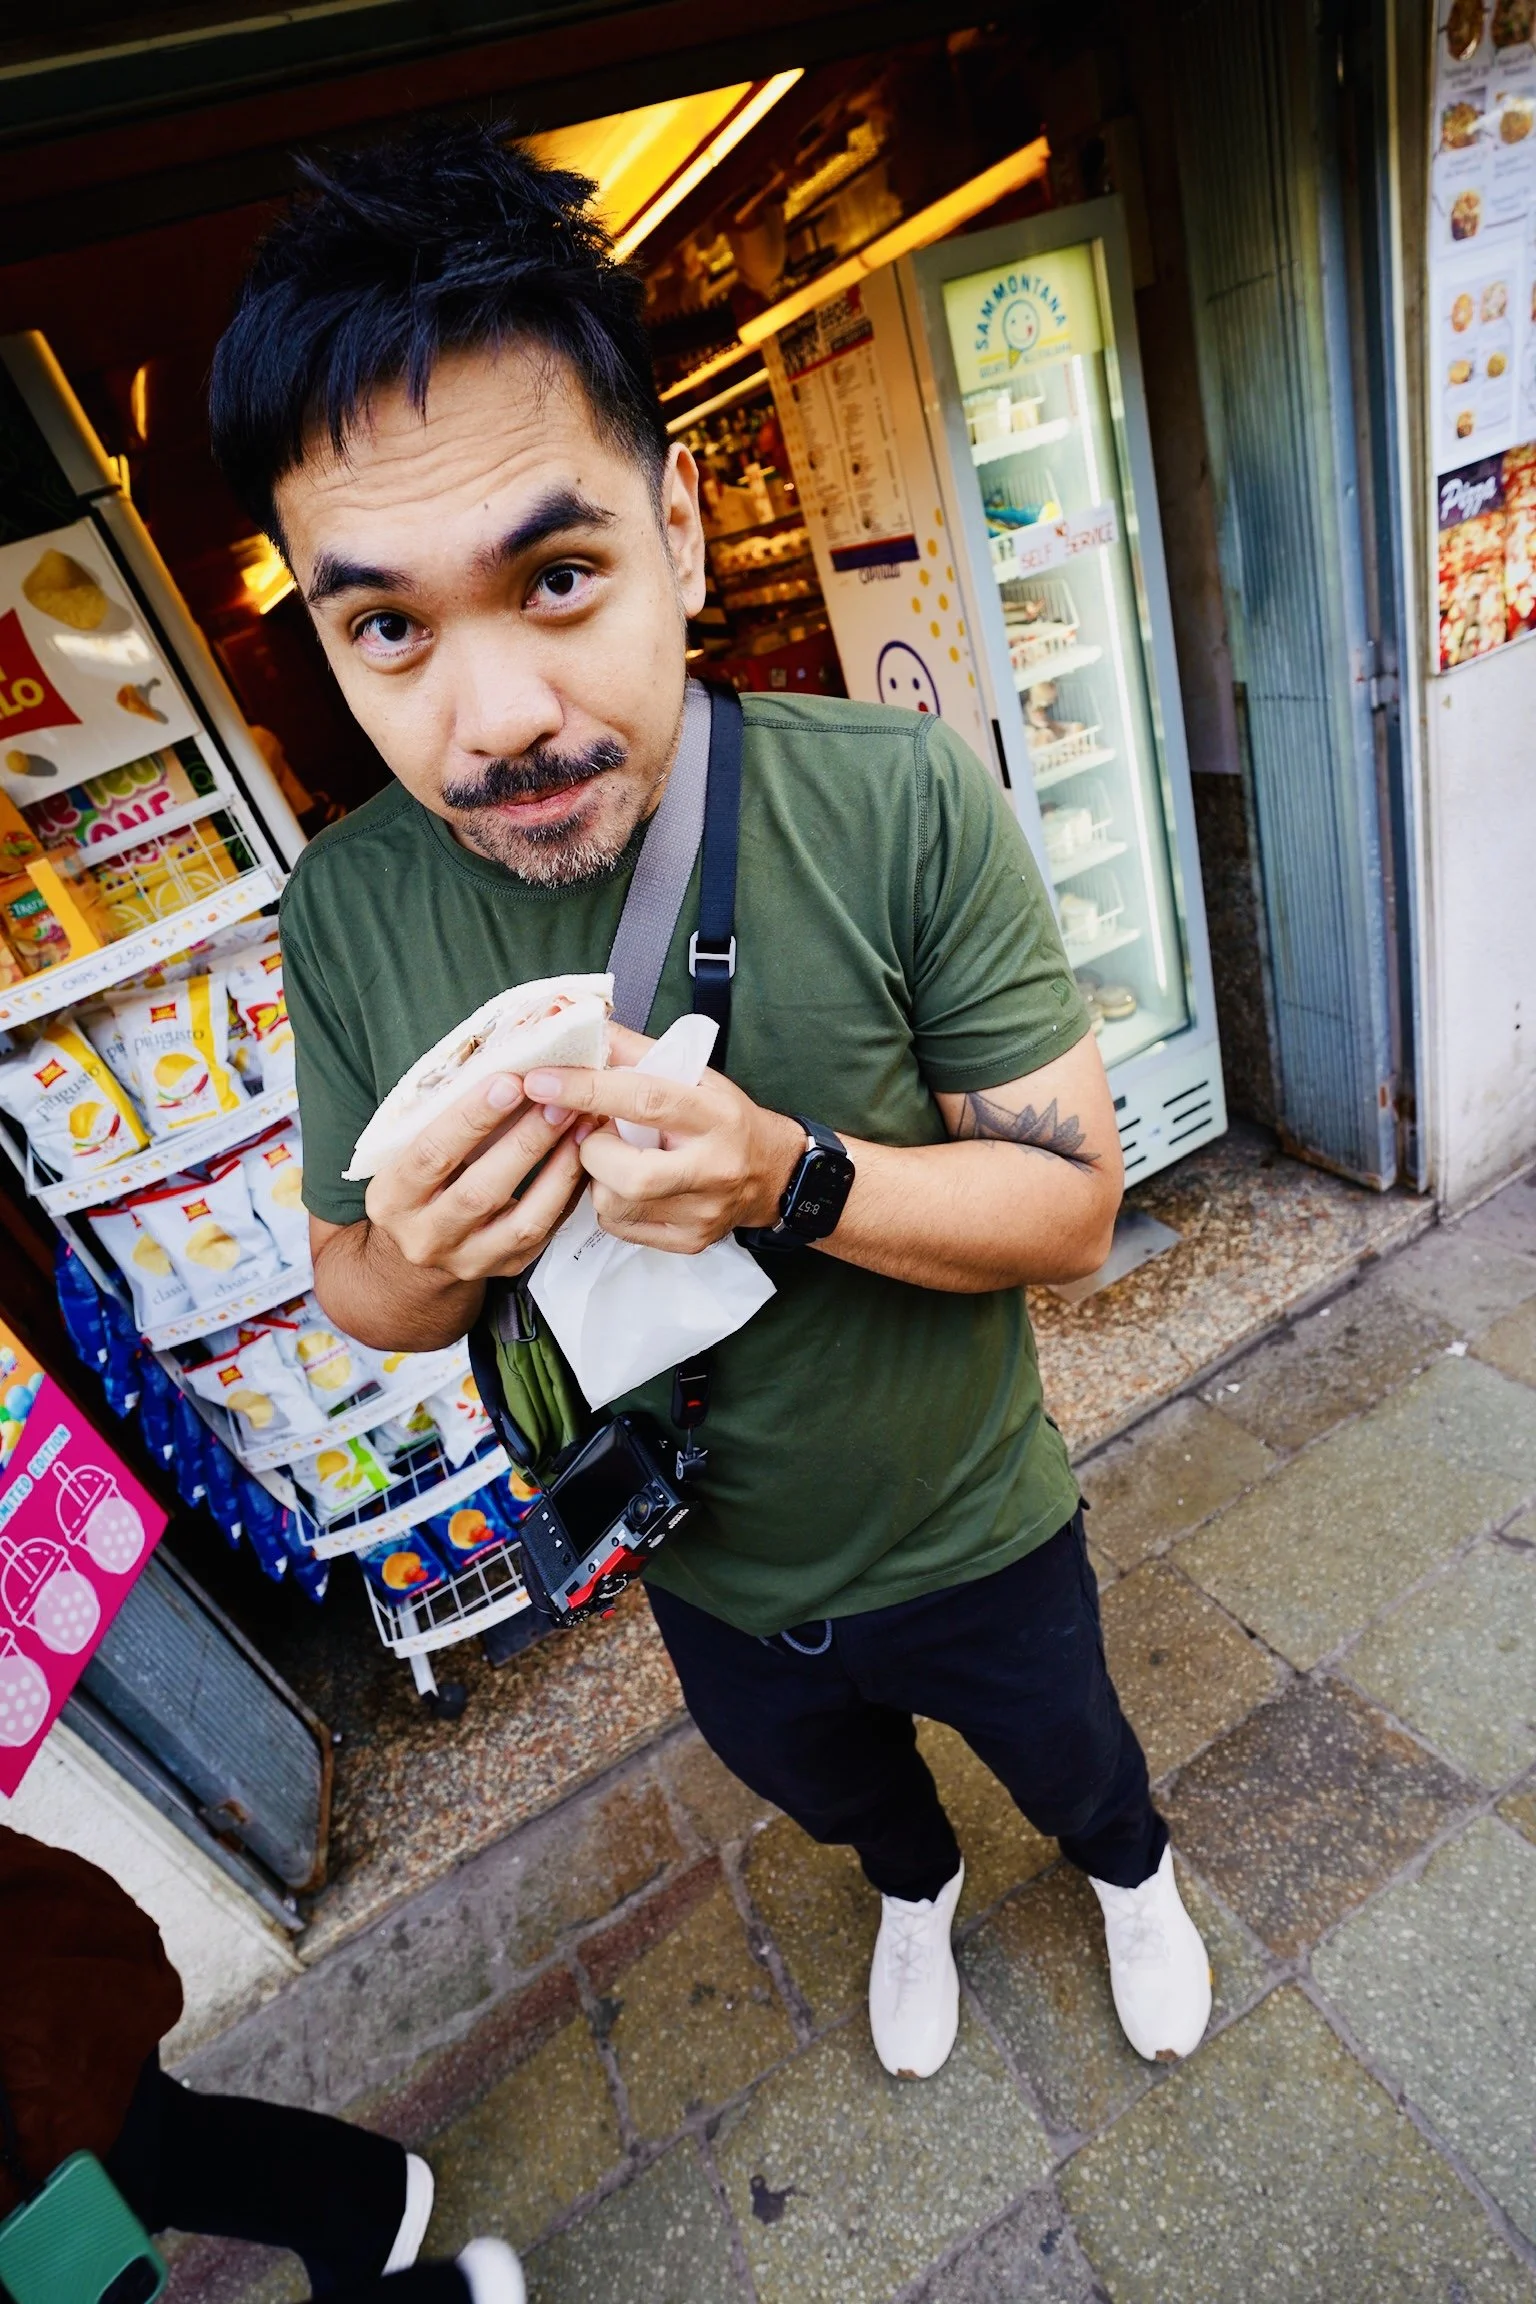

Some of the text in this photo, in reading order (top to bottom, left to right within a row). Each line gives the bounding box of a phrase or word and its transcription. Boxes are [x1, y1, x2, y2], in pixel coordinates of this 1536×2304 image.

[975, 275, 1066, 350] SAMMONTANA
[1440, 476, 1497, 521] Pizza
[1063, 520, 1114, 557] SERVICE
[0, 677, 45, 718] LO
[798, 1200, 820, 1215] 8:57
[29, 1425, 69, 1477] EDITION
